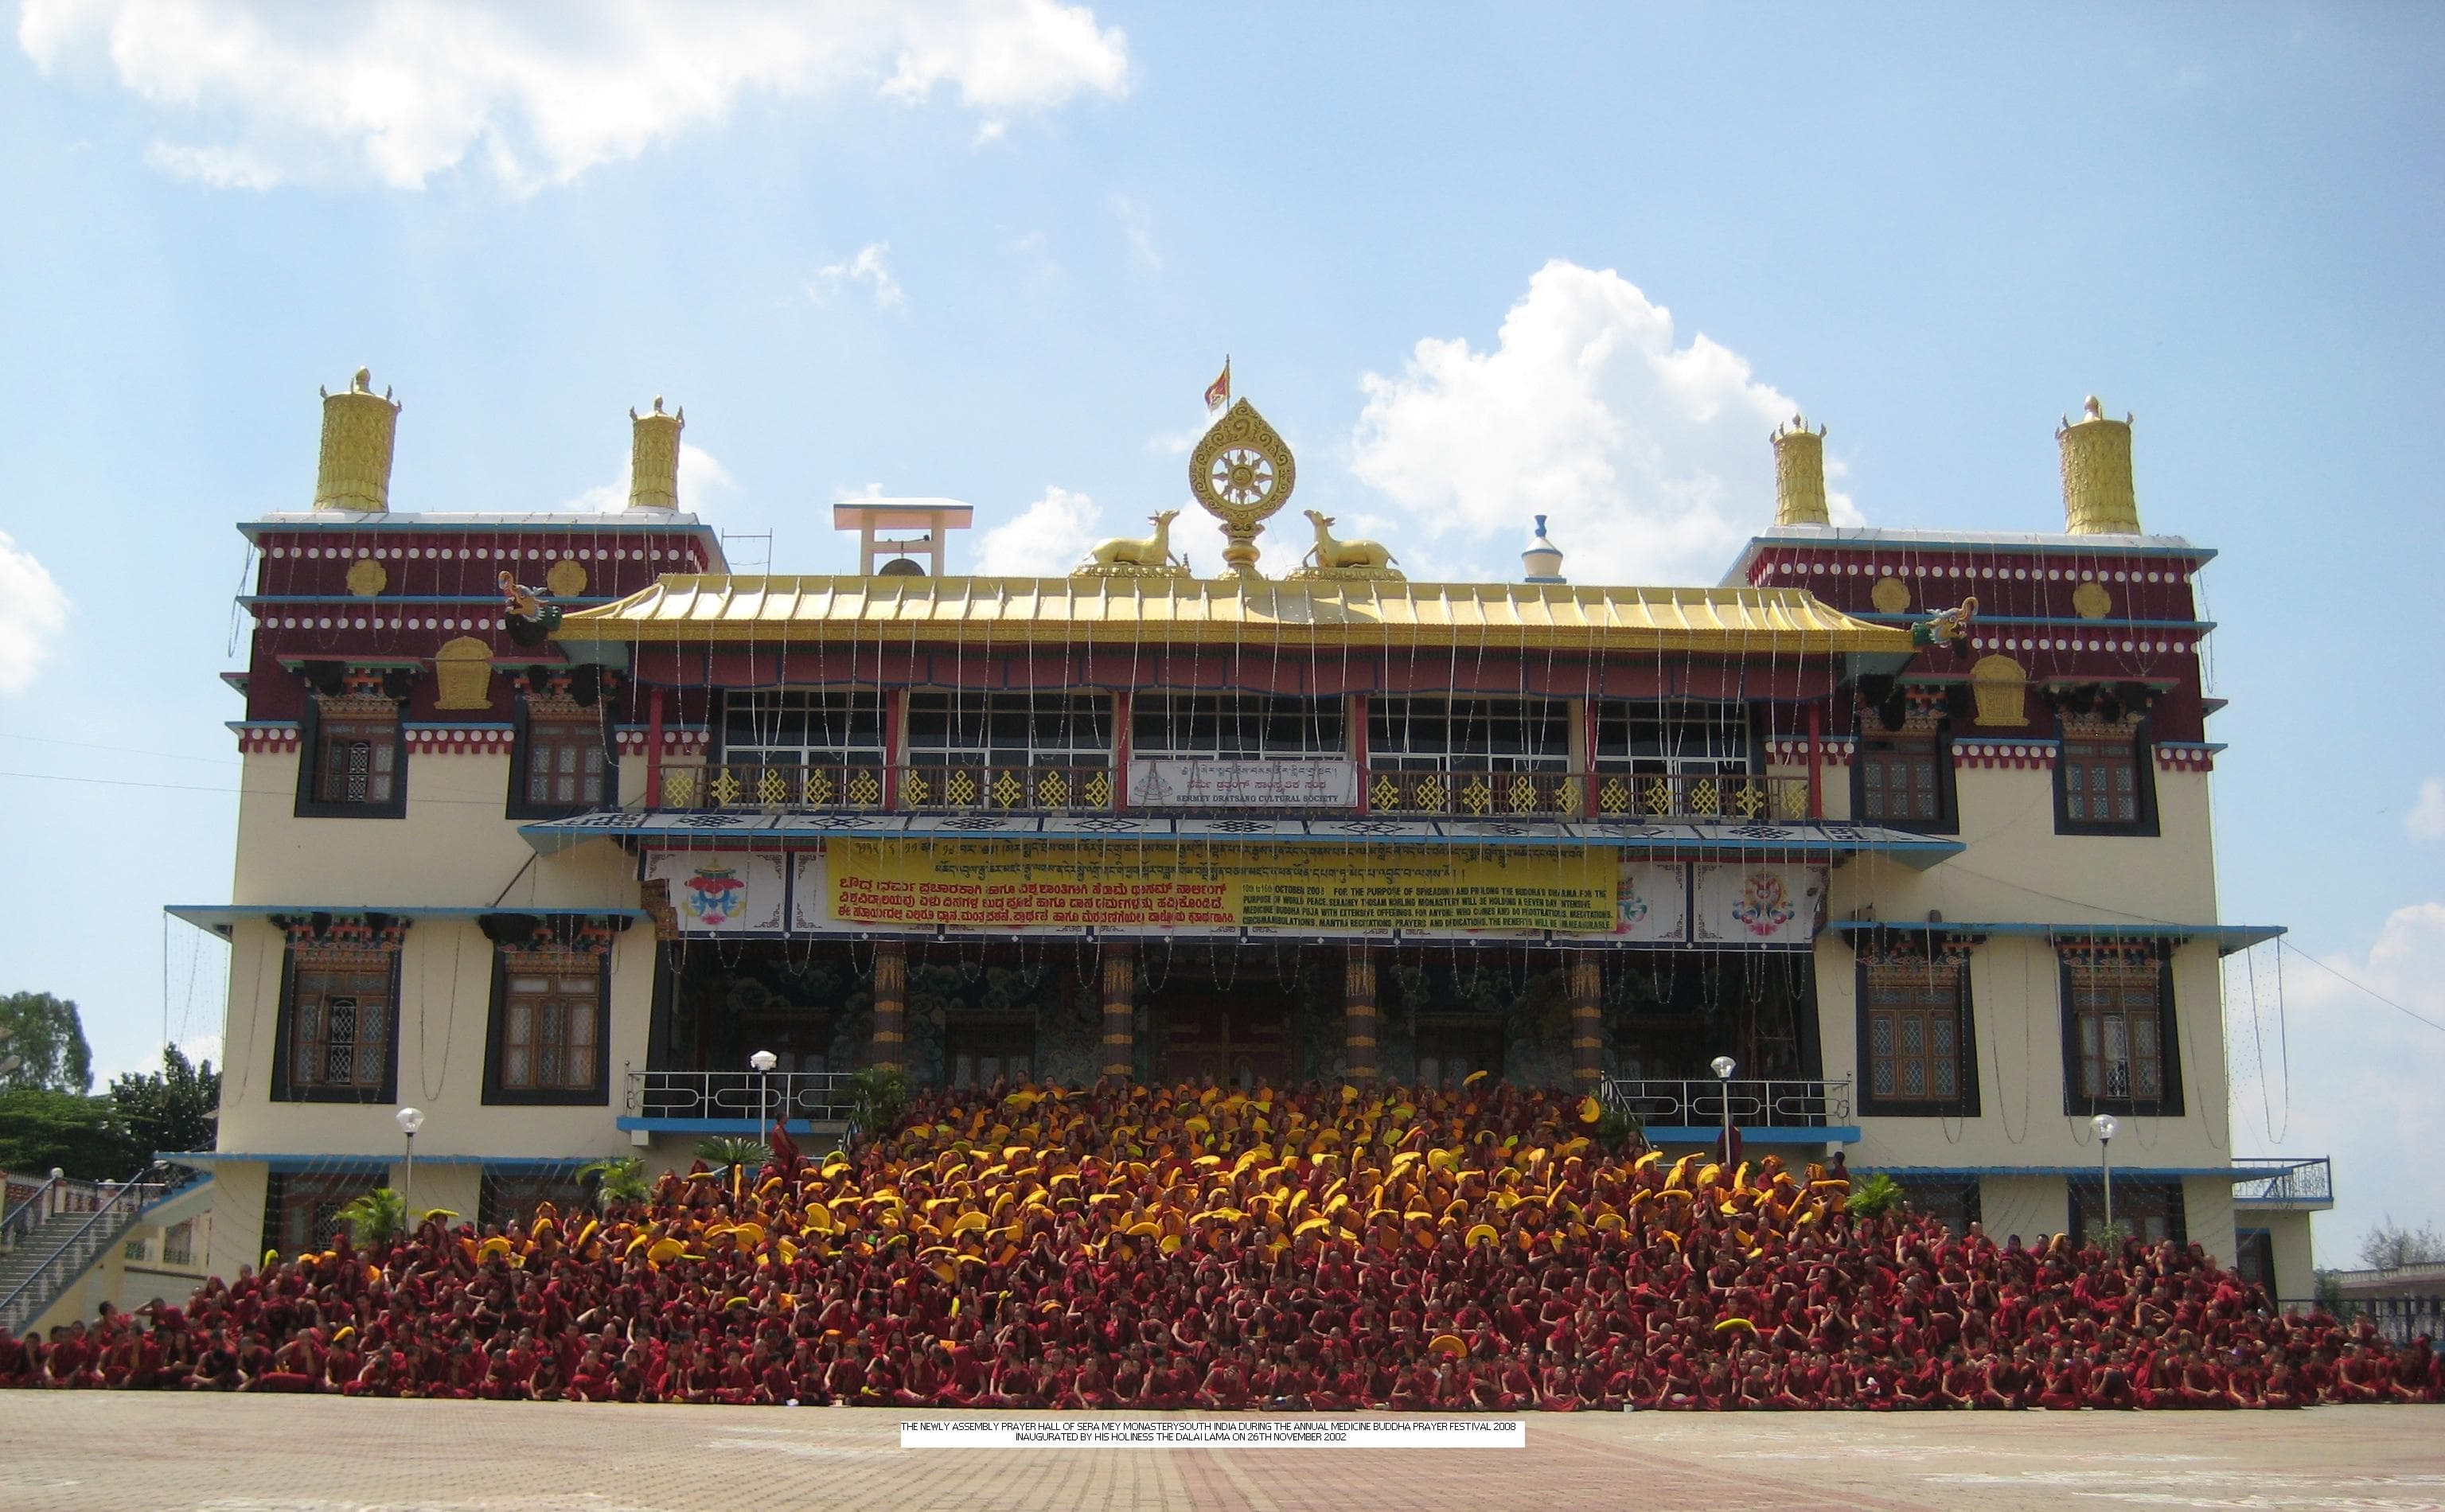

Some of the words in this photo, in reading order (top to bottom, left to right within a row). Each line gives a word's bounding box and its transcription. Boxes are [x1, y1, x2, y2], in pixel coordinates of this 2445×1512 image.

[1275, 885, 1304, 894] OCTOBER
[1334, 887, 1347, 896] FOR
[1351, 887, 1364, 896] THE
[1456, 887, 1468, 895] AND
[1580, 889, 1592, 898] FOR
[1418, 898, 1459, 906] MONASTERY
[1462, 897, 1476, 906] WILL
[1243, 906, 1273, 914] MEDICINE
[1276, 906, 1300, 915] BUDDHA
[1302, 907, 1319, 916] PUJA
[1456, 907, 1470, 916] WHO
[1534, 918, 1548, 927] WILL
